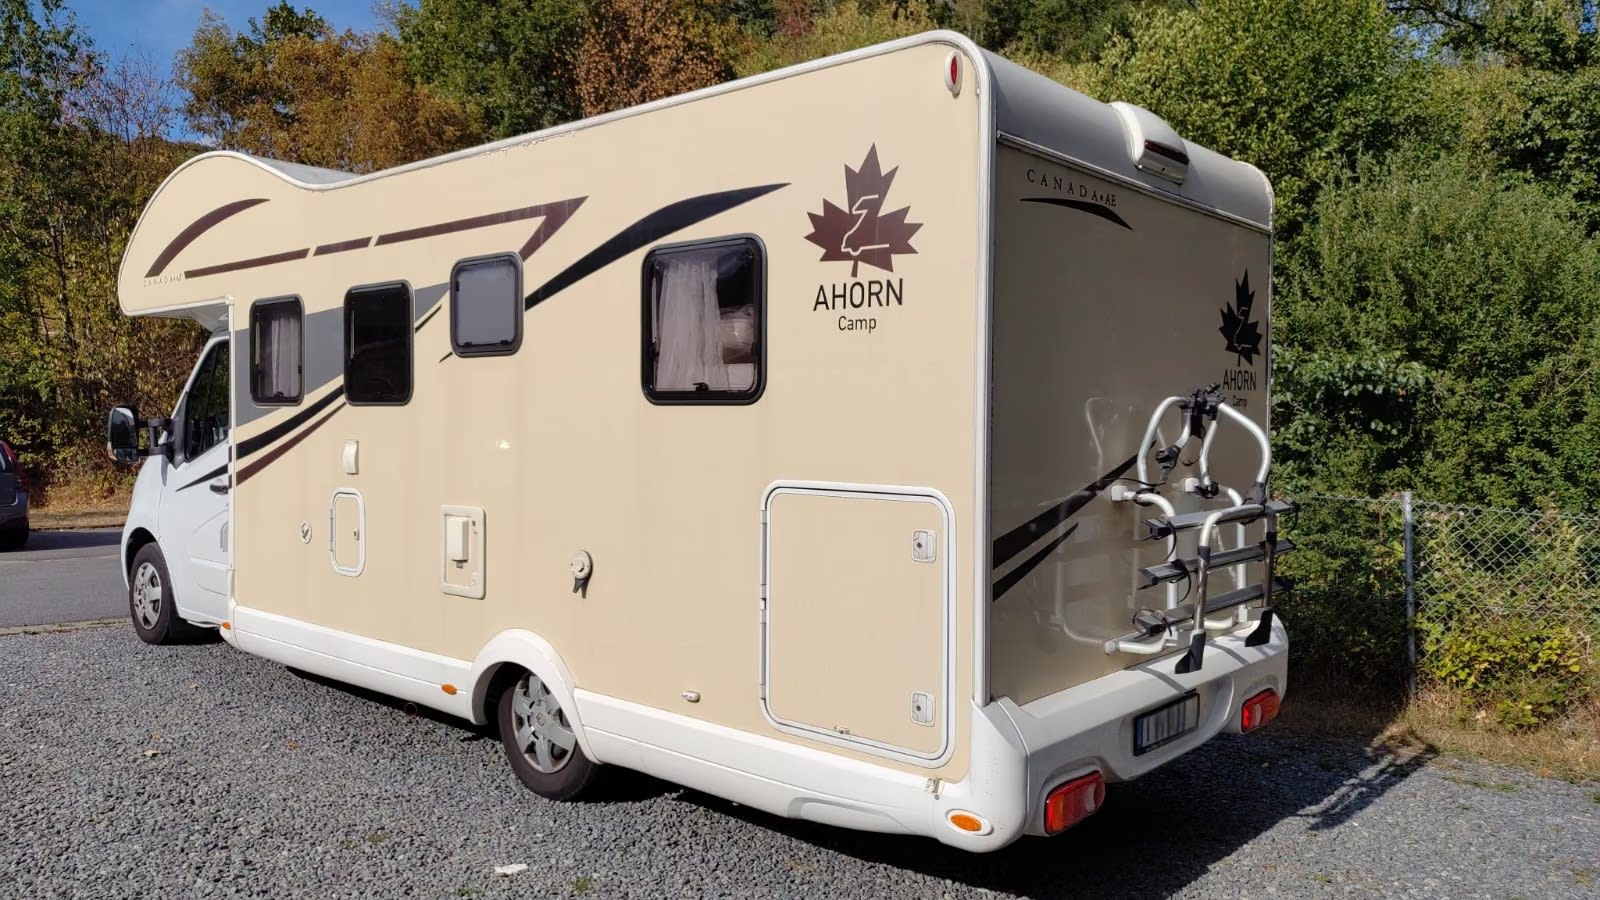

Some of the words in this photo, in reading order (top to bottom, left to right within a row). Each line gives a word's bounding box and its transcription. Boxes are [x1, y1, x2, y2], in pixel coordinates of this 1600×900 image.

[1026, 168, 1098, 202] CANADA
[813, 278, 903, 311] AHORN
[838, 315, 877, 334] Camp
[1222, 369, 1257, 391] AHORN
[1232, 394, 1248, 410] Camp
